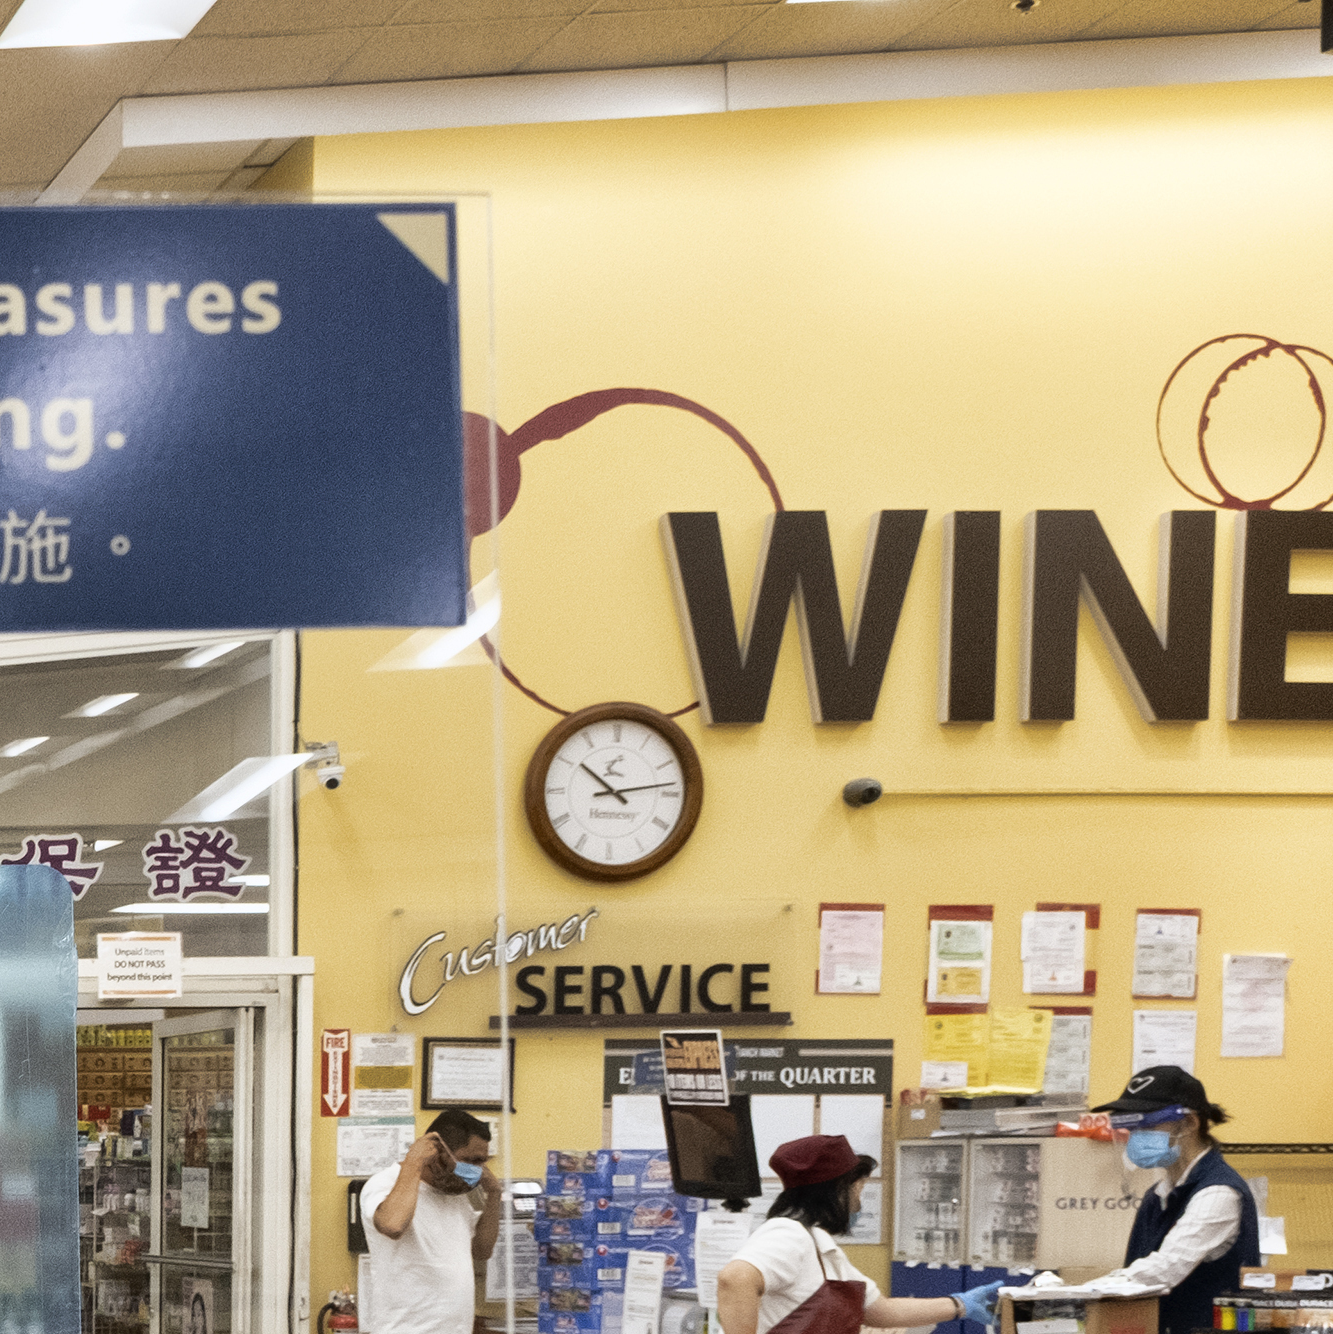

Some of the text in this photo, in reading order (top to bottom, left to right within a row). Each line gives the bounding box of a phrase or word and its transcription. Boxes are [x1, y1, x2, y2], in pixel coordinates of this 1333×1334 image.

[661, 508, 1333, 727] WINE
[114, 947, 165, 957] Unpaid items
[114, 960, 166, 969] DO NOT PASS
[398, 906, 600, 1017] Customer
[107, 972, 172, 982] beyond this point
[514, 962, 771, 1016] SERVICE
[325, 1037, 346, 1049] FIRE
[750, 1070, 775, 1082] THE
[779, 1067, 876, 1088] QUARTER
[1055, 1197, 1114, 1212] GREY
